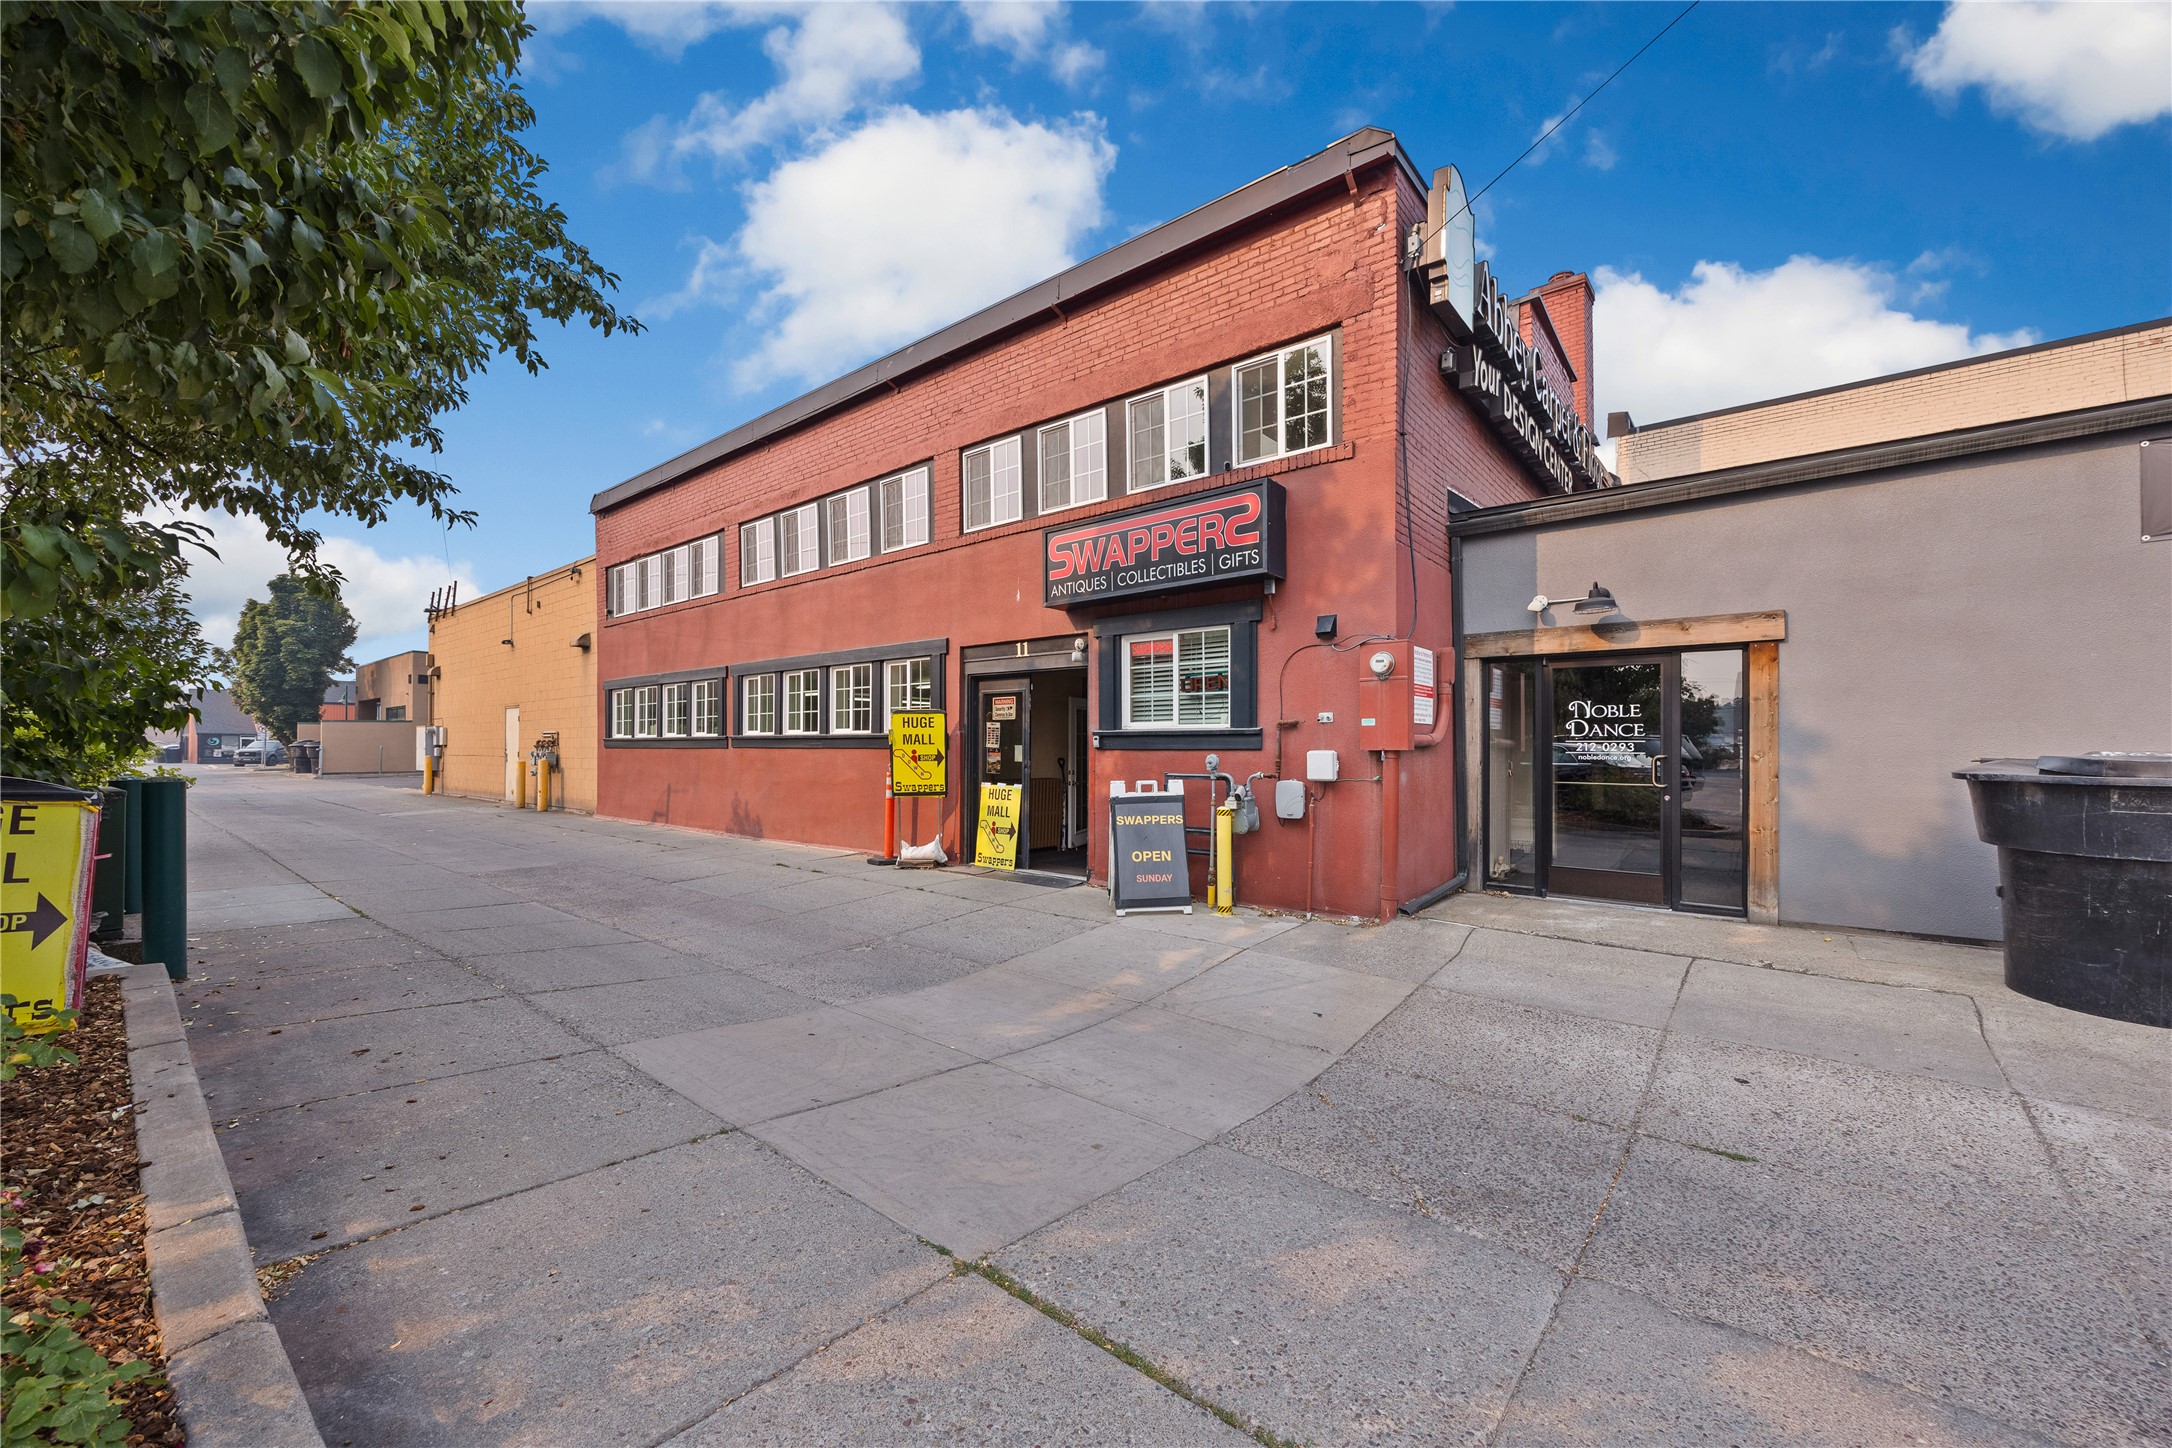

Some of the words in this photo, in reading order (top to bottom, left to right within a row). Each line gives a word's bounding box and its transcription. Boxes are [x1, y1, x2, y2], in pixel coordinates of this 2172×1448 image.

[1477, 262, 1530, 391] Abbey
[1533, 347, 1572, 446] Carpet
[1472, 344, 1502, 397] Your
[1504, 383, 1543, 460] DESIGN
[1543, 438, 1574, 495] CENTER
[1048, 492, 1262, 581] SWAPPERS
[1050, 576, 1107, 598] ANTIQUES
[1117, 558, 1206, 587] COLLECTIBLES
[1219, 549, 1260, 570] GIFTS
[1016, 642, 1029, 657] 11
[902, 717, 935, 728] HUGE
[902, 734, 935, 745] MALL
[1576, 743, 1635, 752] 212-0293
[1578, 754, 1632, 762] nobledance.org
[895, 782, 945, 792] Swappers
[988, 788, 1013, 801] HUGE
[987, 805, 1011, 818] MALL
[0, 805, 38, 835] E
[1116, 815, 1184, 825] SWAPPERS
[977, 852, 1014, 867] Swappers
[1131, 850, 1172, 862] OPEN
[1136, 873, 1173, 882] SUNDAY
